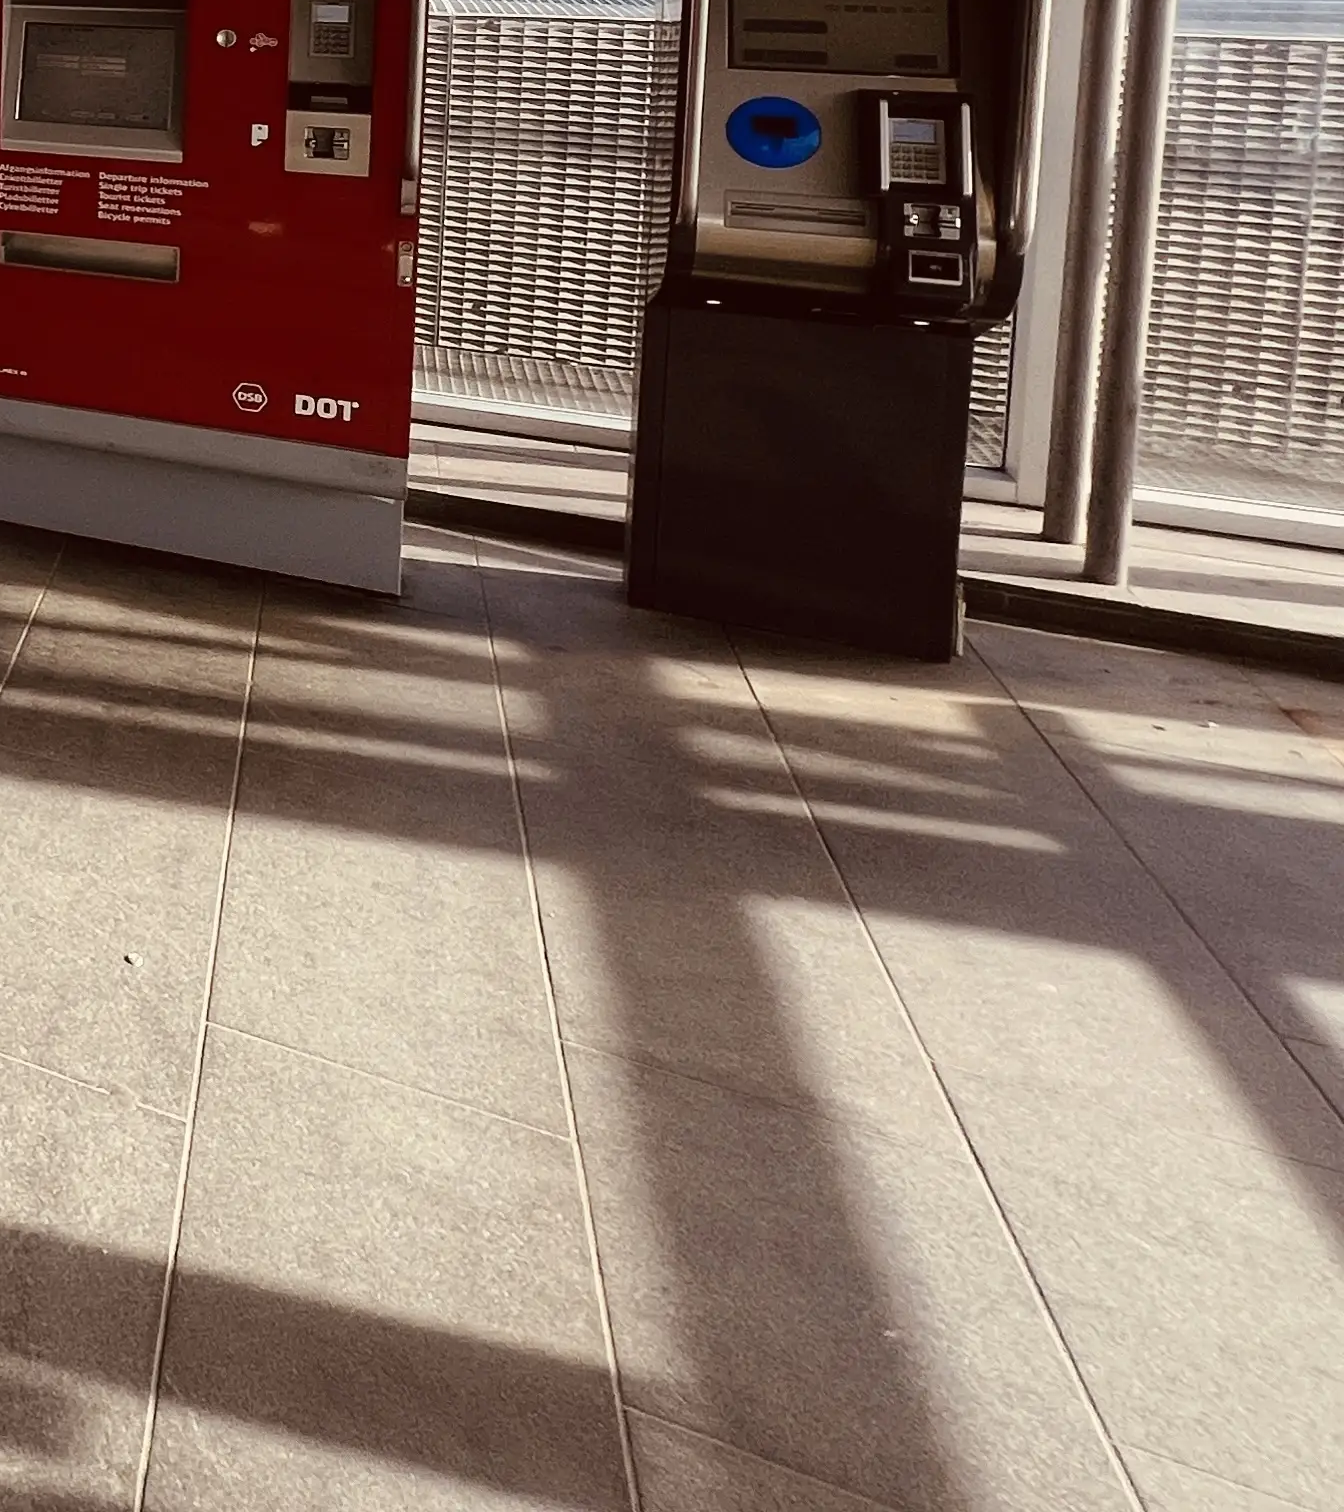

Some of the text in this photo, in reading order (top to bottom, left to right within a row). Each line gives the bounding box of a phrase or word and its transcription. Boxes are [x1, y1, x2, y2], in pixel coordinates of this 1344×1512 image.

[99, 172, 209, 188] Departure information
[99, 181, 183, 196] Single trip tickets
[98, 191, 165, 204] Tourist tickets
[98, 201, 181, 216] Seat reservations
[98, 210, 171, 225] Bicycle permits
[237, 391, 263, 403] DSB
[294, 394, 353, 421] DOT
